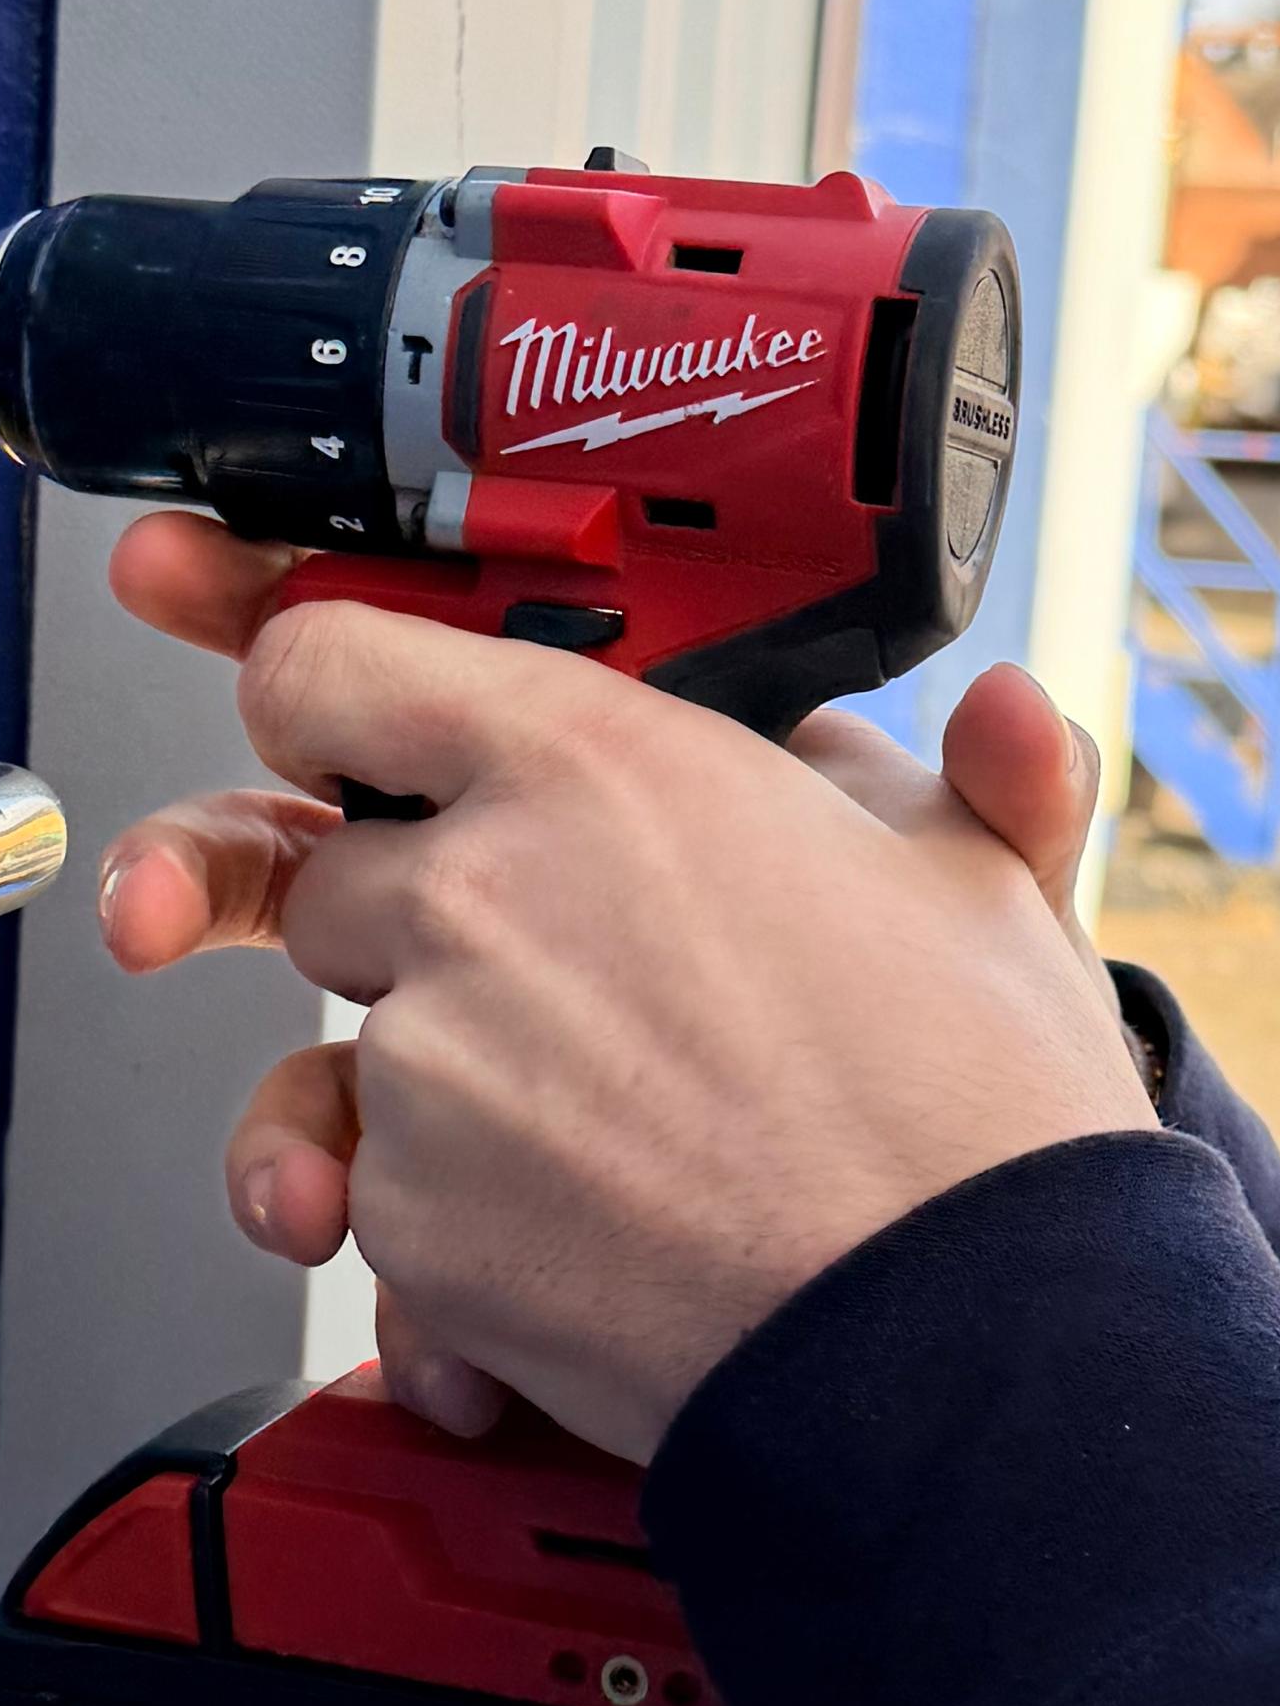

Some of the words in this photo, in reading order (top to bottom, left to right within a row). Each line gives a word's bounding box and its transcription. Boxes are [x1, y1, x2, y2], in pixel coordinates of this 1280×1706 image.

[359, 186, 402, 205] 10
[330, 246, 367, 267] 8
[311, 339, 347, 364] 6
[499, 314, 826, 417] Milwaukee
[952, 397, 1010, 440] BRUSHLESS
[311, 435, 345, 459] 4
[329, 515, 364, 532] 2
